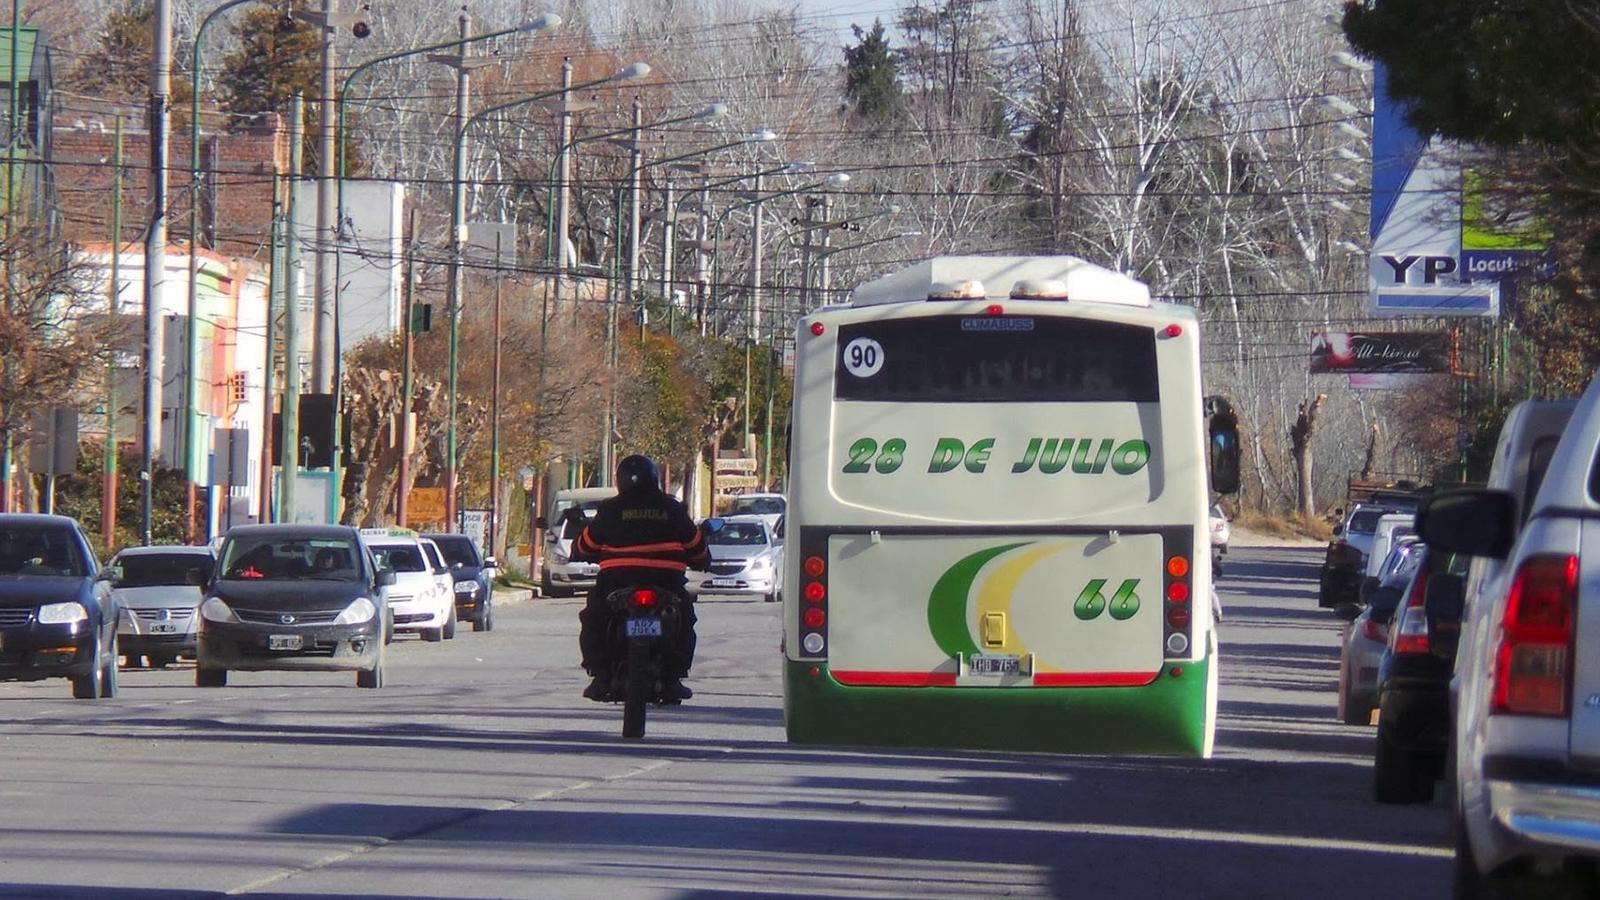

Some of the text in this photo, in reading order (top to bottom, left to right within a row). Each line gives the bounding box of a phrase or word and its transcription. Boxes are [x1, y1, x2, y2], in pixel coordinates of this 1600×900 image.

[1381, 255, 1473, 284] YP
[962, 319, 1034, 330] CLIMABUSS
[850, 344, 877, 369] 90
[842, 437, 1151, 475] 28 DE JULIO
[1073, 578, 1141, 621] 66
